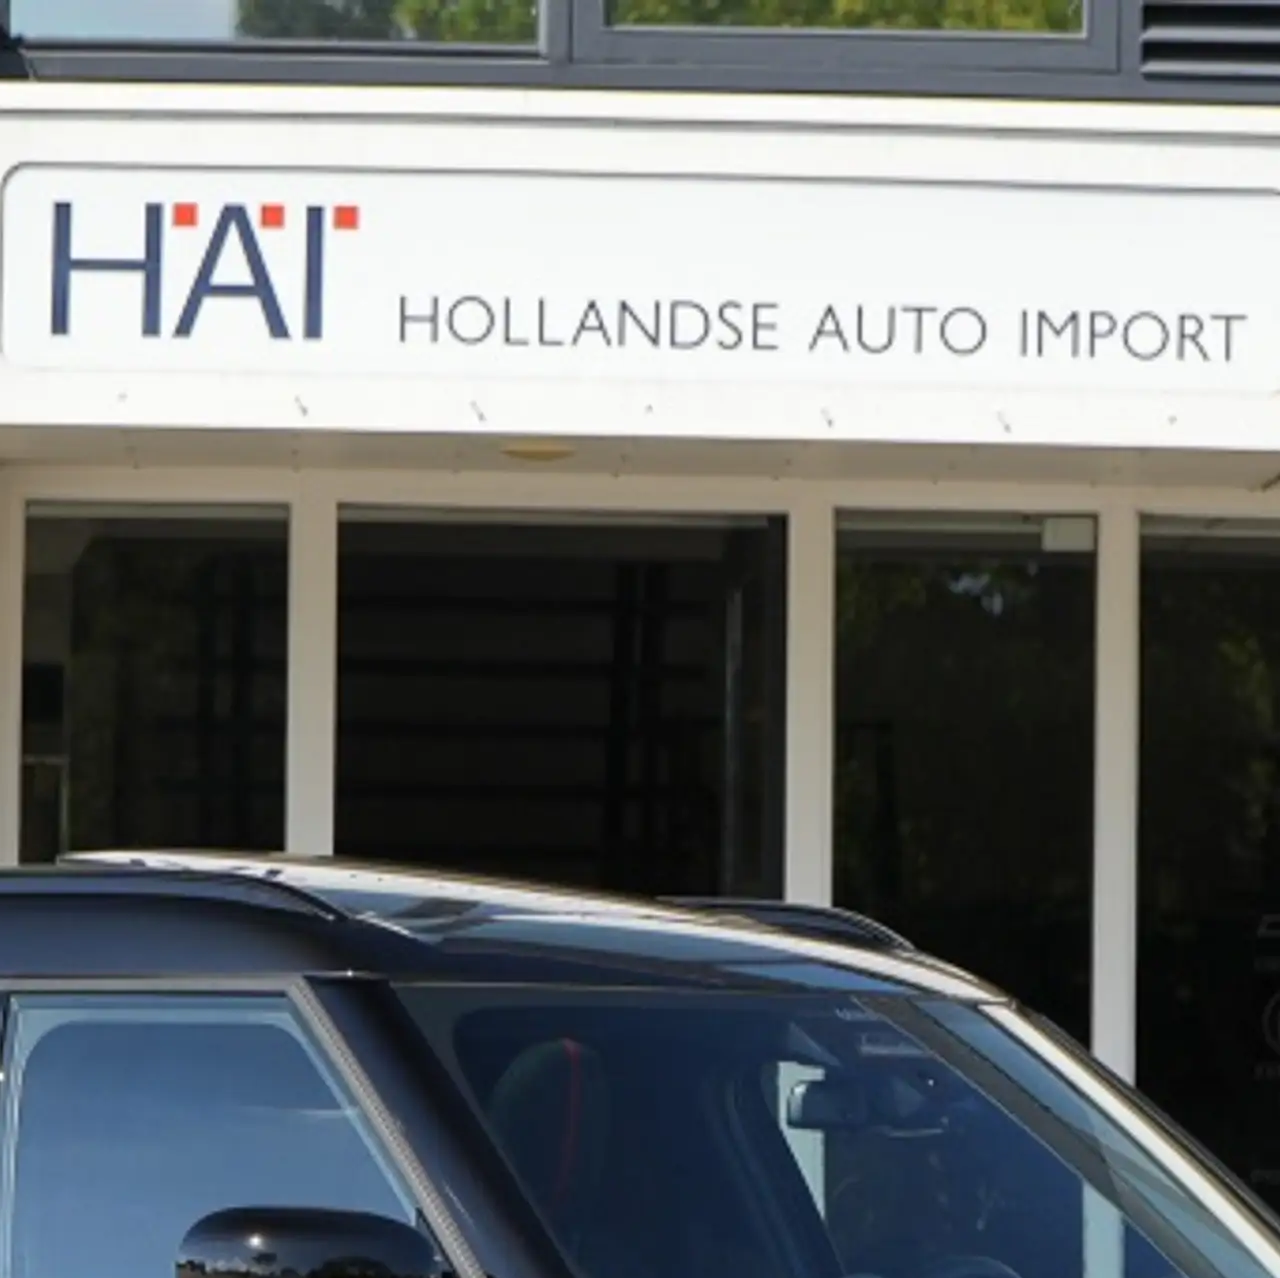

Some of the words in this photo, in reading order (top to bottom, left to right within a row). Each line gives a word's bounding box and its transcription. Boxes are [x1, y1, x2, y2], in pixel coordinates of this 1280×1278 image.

[50, 200, 330, 340] HAI
[398, 294, 779, 352] HOLLANDSE
[808, 304, 989, 355] AUTO
[1019, 310, 1248, 362] IMPORT
